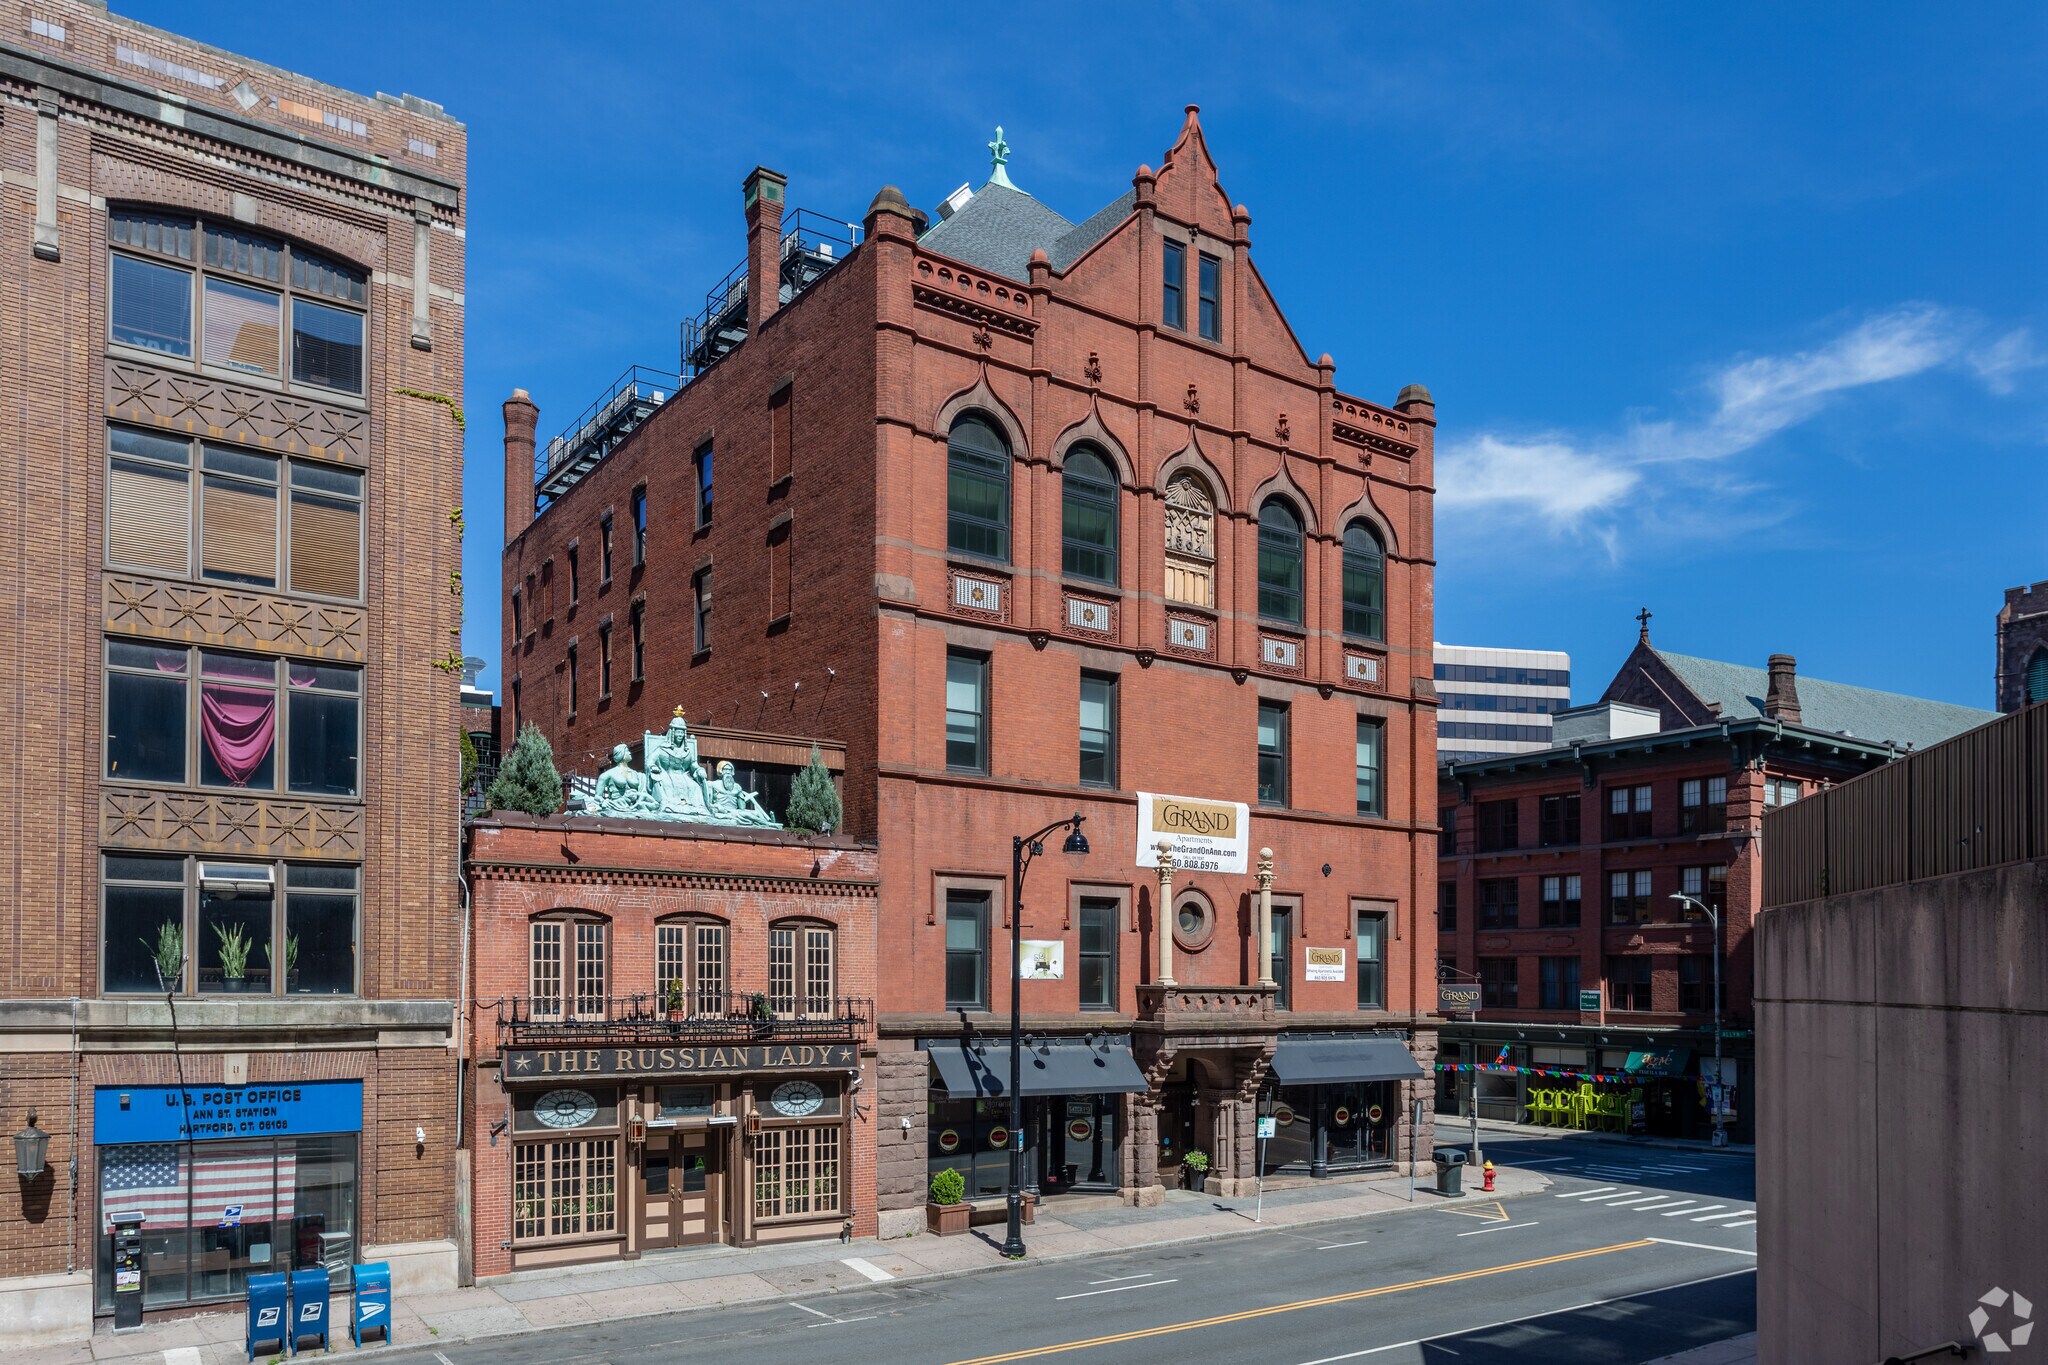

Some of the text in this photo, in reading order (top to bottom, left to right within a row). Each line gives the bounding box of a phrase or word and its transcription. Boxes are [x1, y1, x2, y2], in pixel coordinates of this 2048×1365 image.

[1163, 804, 1229, 834] GRAND
[1176, 834, 1213, 844] Apartments
[1150, 844, 1237, 857] wwTheGrandOnAnn.com
[1170, 859, 1219, 870] 60.808.6976
[1311, 952, 1340, 965] GRAND
[1441, 989, 1480, 1003] GRAND
[537, 1044, 835, 1073] THE RUSSIAN LADY
[203, 1091, 242, 1106] POST
[247, 1089, 302, 1103] OFFICE
[193, 1106, 277, 1120] ANN ST. STATION
[179, 1122, 236, 1134] HARTFORD,
[240, 1121, 255, 1132] CT.
[696, 1157, 704, 1165] A
